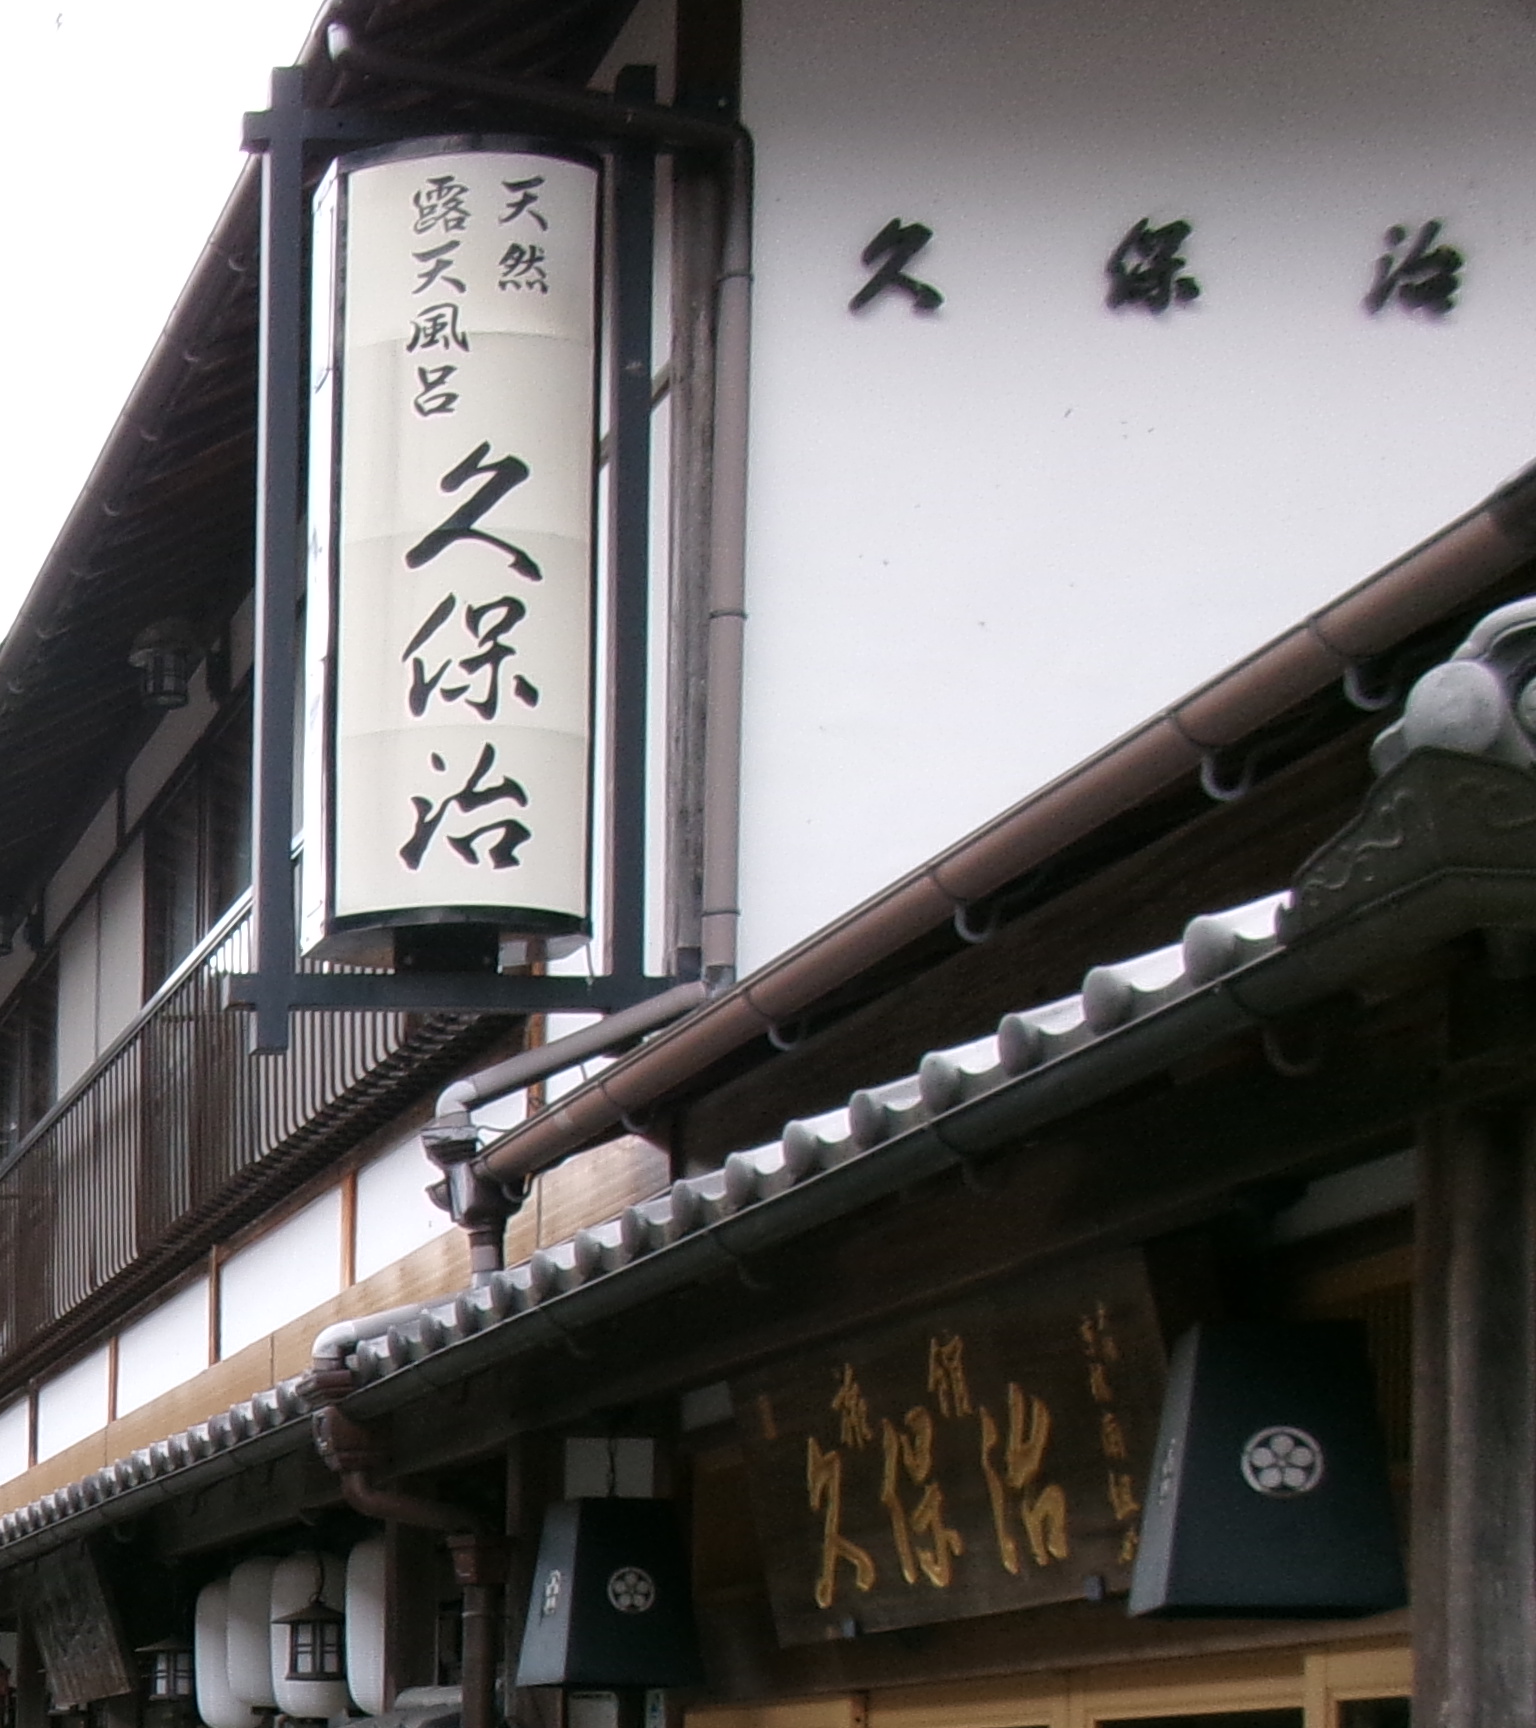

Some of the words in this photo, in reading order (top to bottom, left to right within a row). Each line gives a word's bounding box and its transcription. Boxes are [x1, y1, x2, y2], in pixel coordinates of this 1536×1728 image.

[406, 175, 470, 418] 露天風呂
[498, 177, 550, 296] 天然
[398, 440, 543, 873] 久保治
